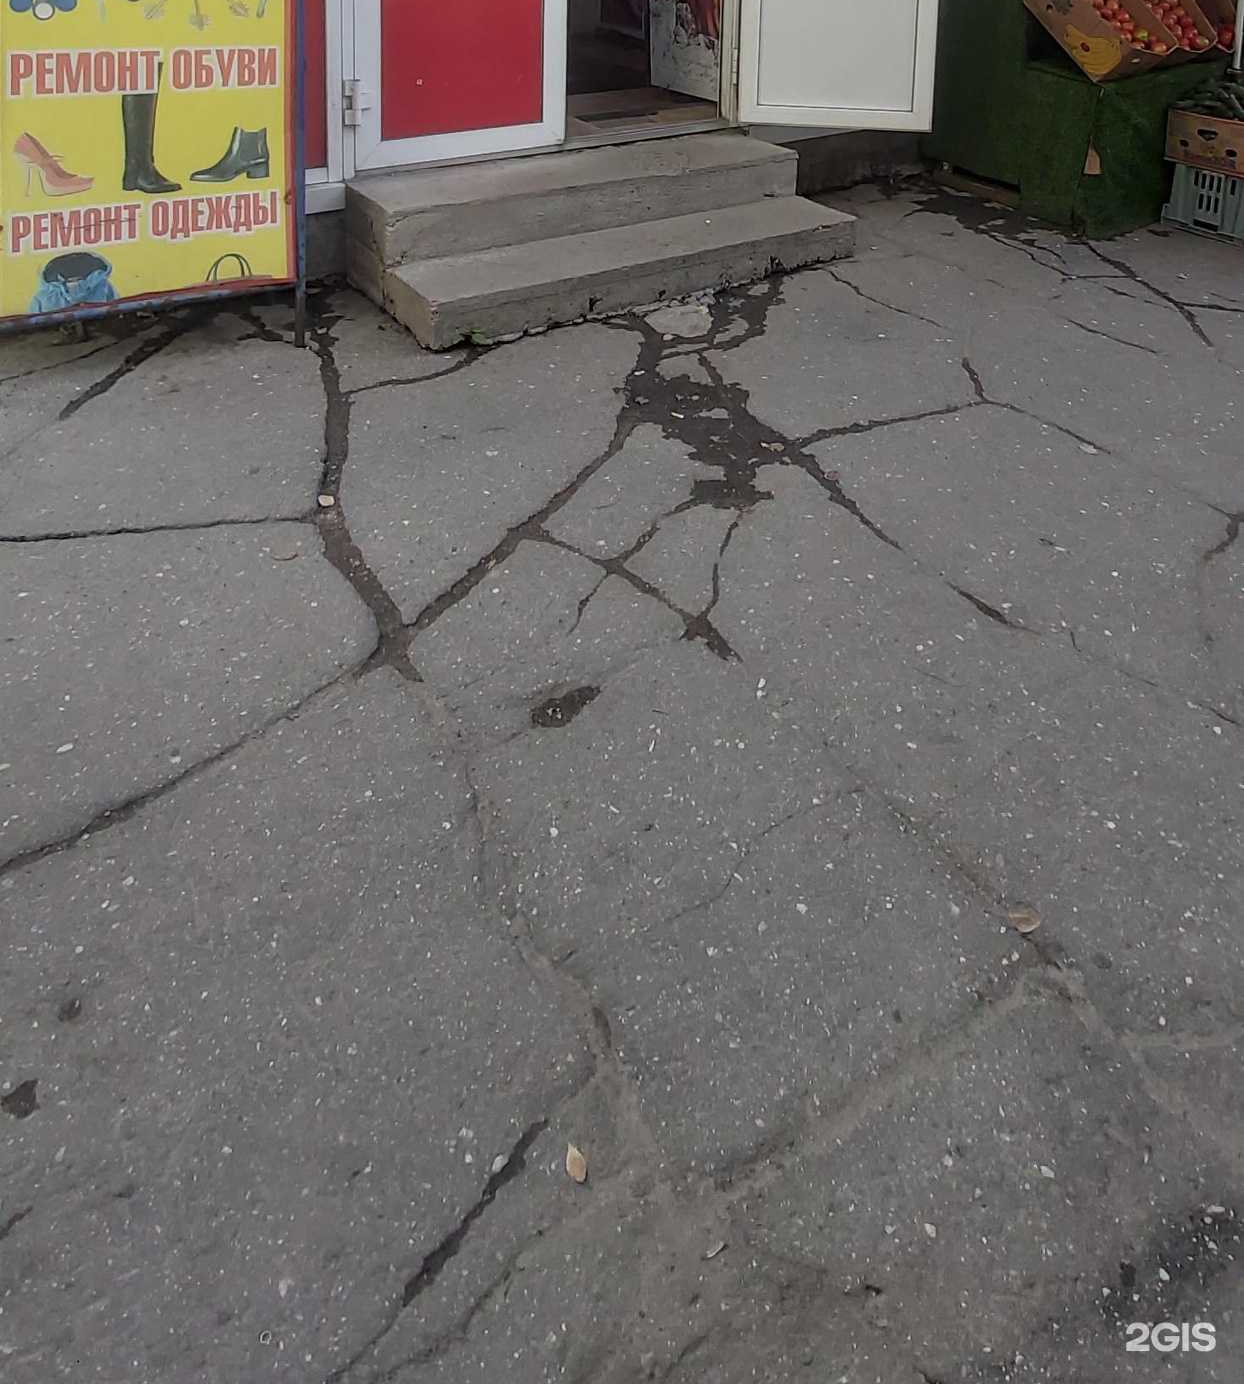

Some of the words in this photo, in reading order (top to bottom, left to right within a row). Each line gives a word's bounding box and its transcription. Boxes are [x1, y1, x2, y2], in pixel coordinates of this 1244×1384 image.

[10, 50, 160, 96] РЕМОНТ
[172, 48, 277, 89] ОБУВИ
[12, 204, 140, 252] РЕМОНТ
[152, 191, 278, 238] ОДЕЖДЫ
